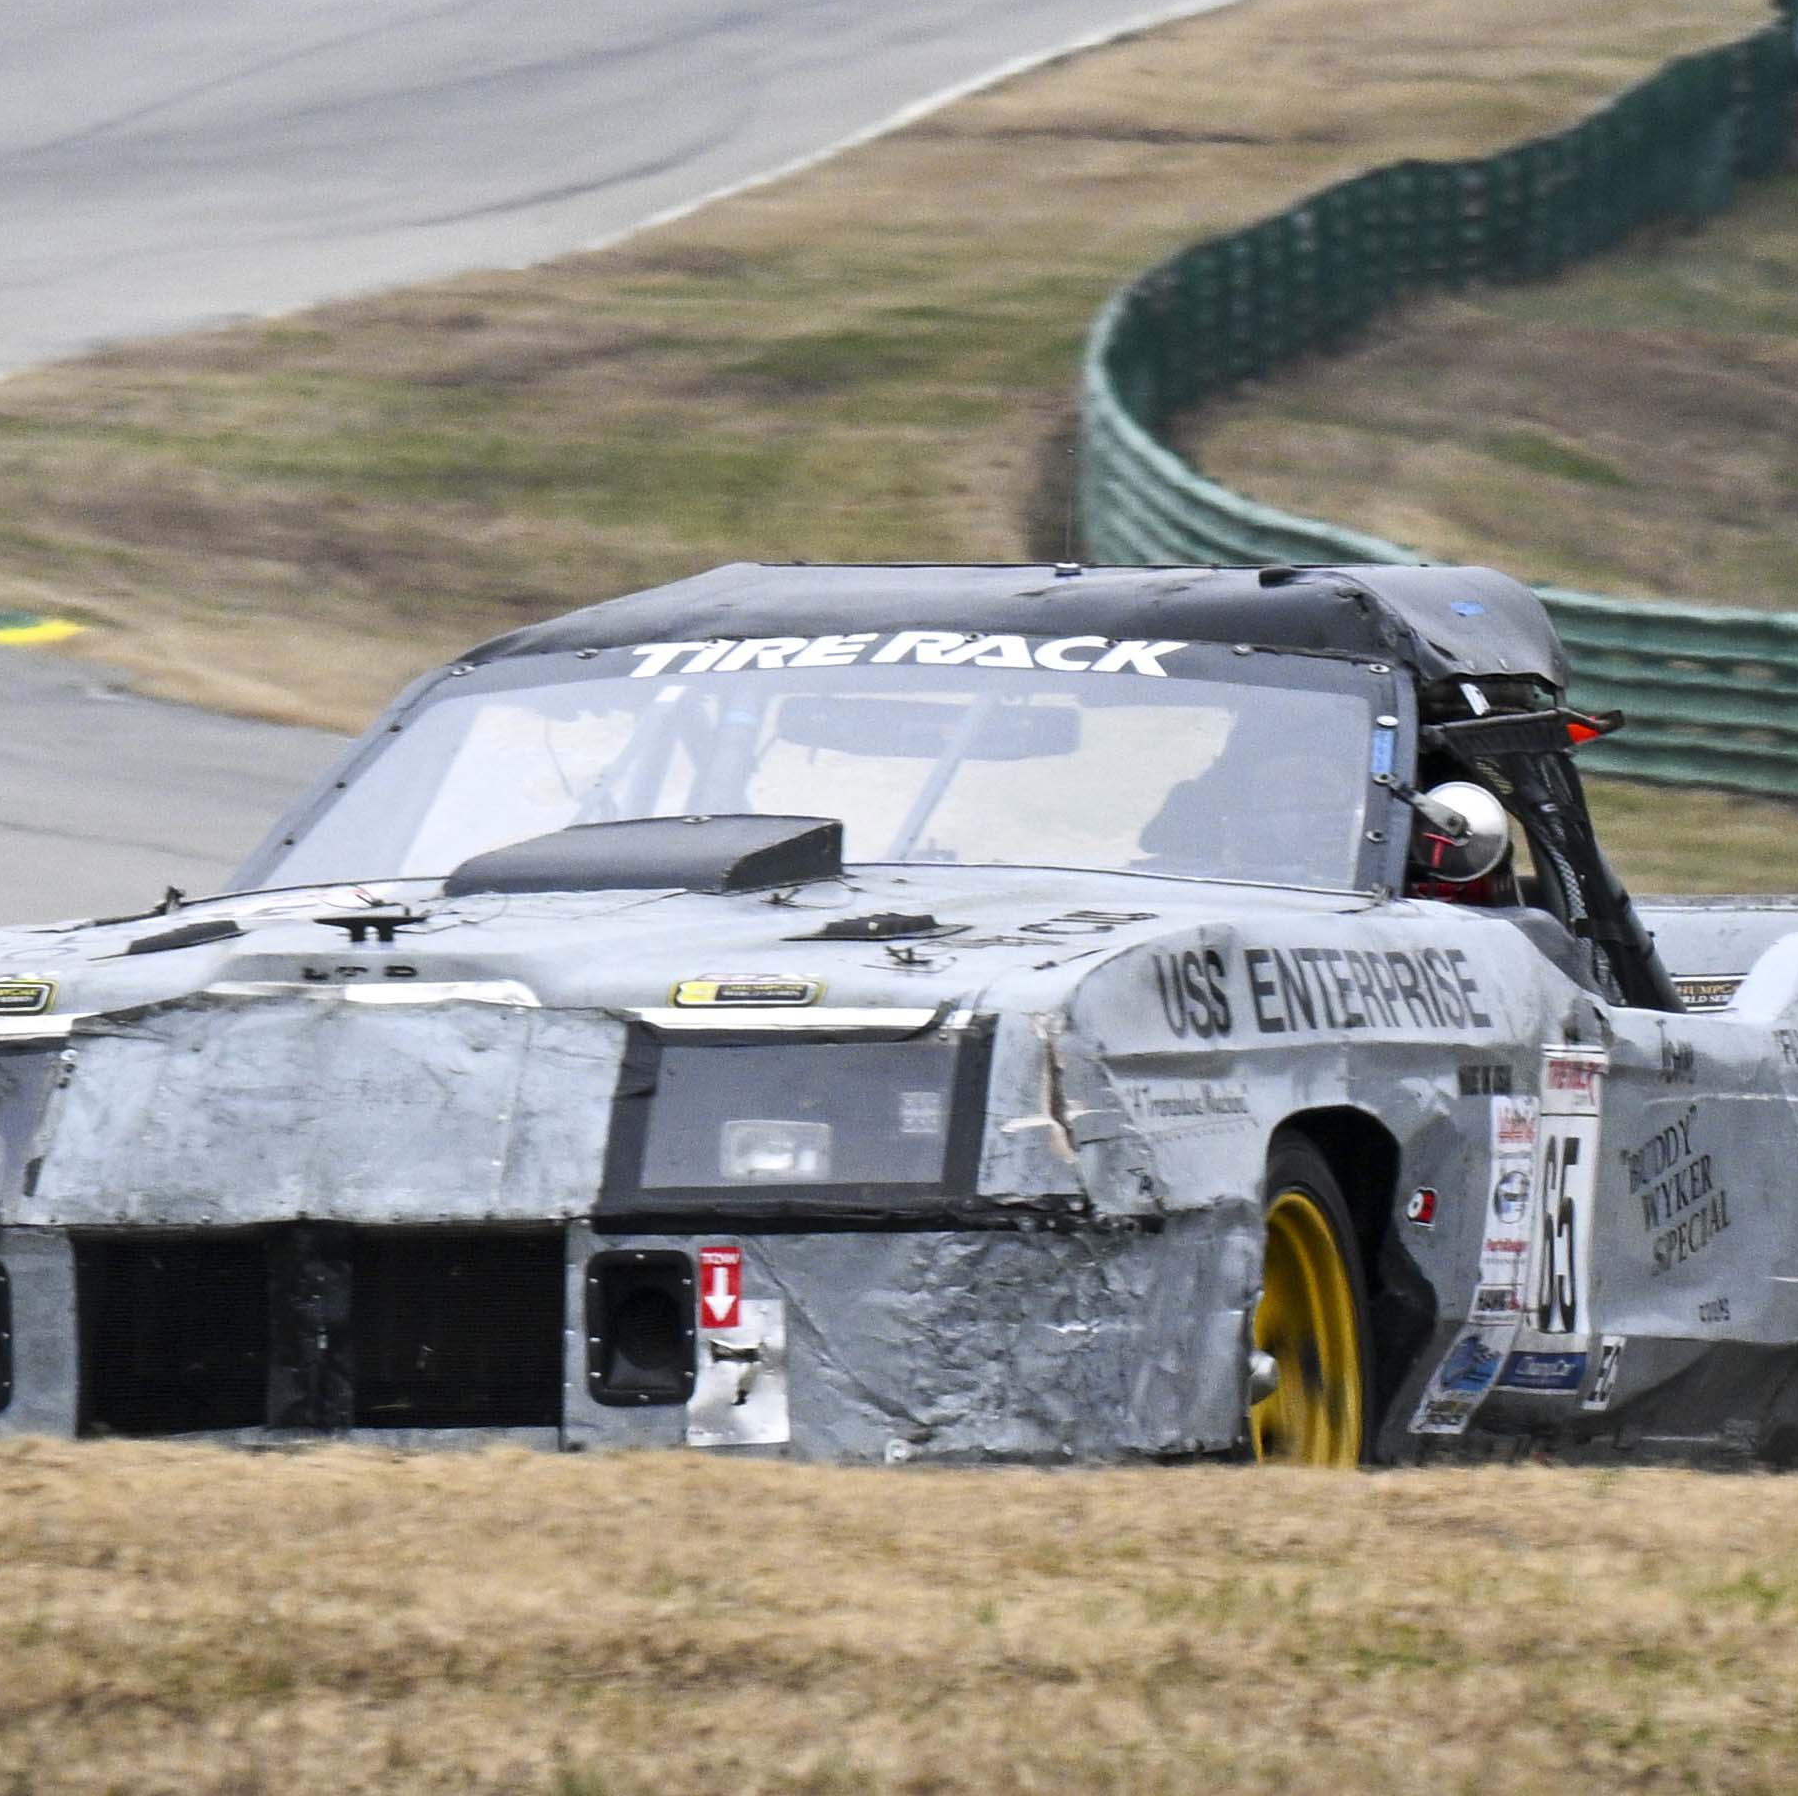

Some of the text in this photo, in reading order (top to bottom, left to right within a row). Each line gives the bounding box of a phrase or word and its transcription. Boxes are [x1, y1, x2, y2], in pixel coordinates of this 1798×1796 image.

[630, 630, 1189, 679] TIRE RACK
[1154, 946, 1493, 1040] USS ENTERPRISE
[1537, 1134, 1578, 1334] 65
[1641, 1154, 1713, 1232] WYKER
[1652, 1190, 1731, 1277] SPECIAL
